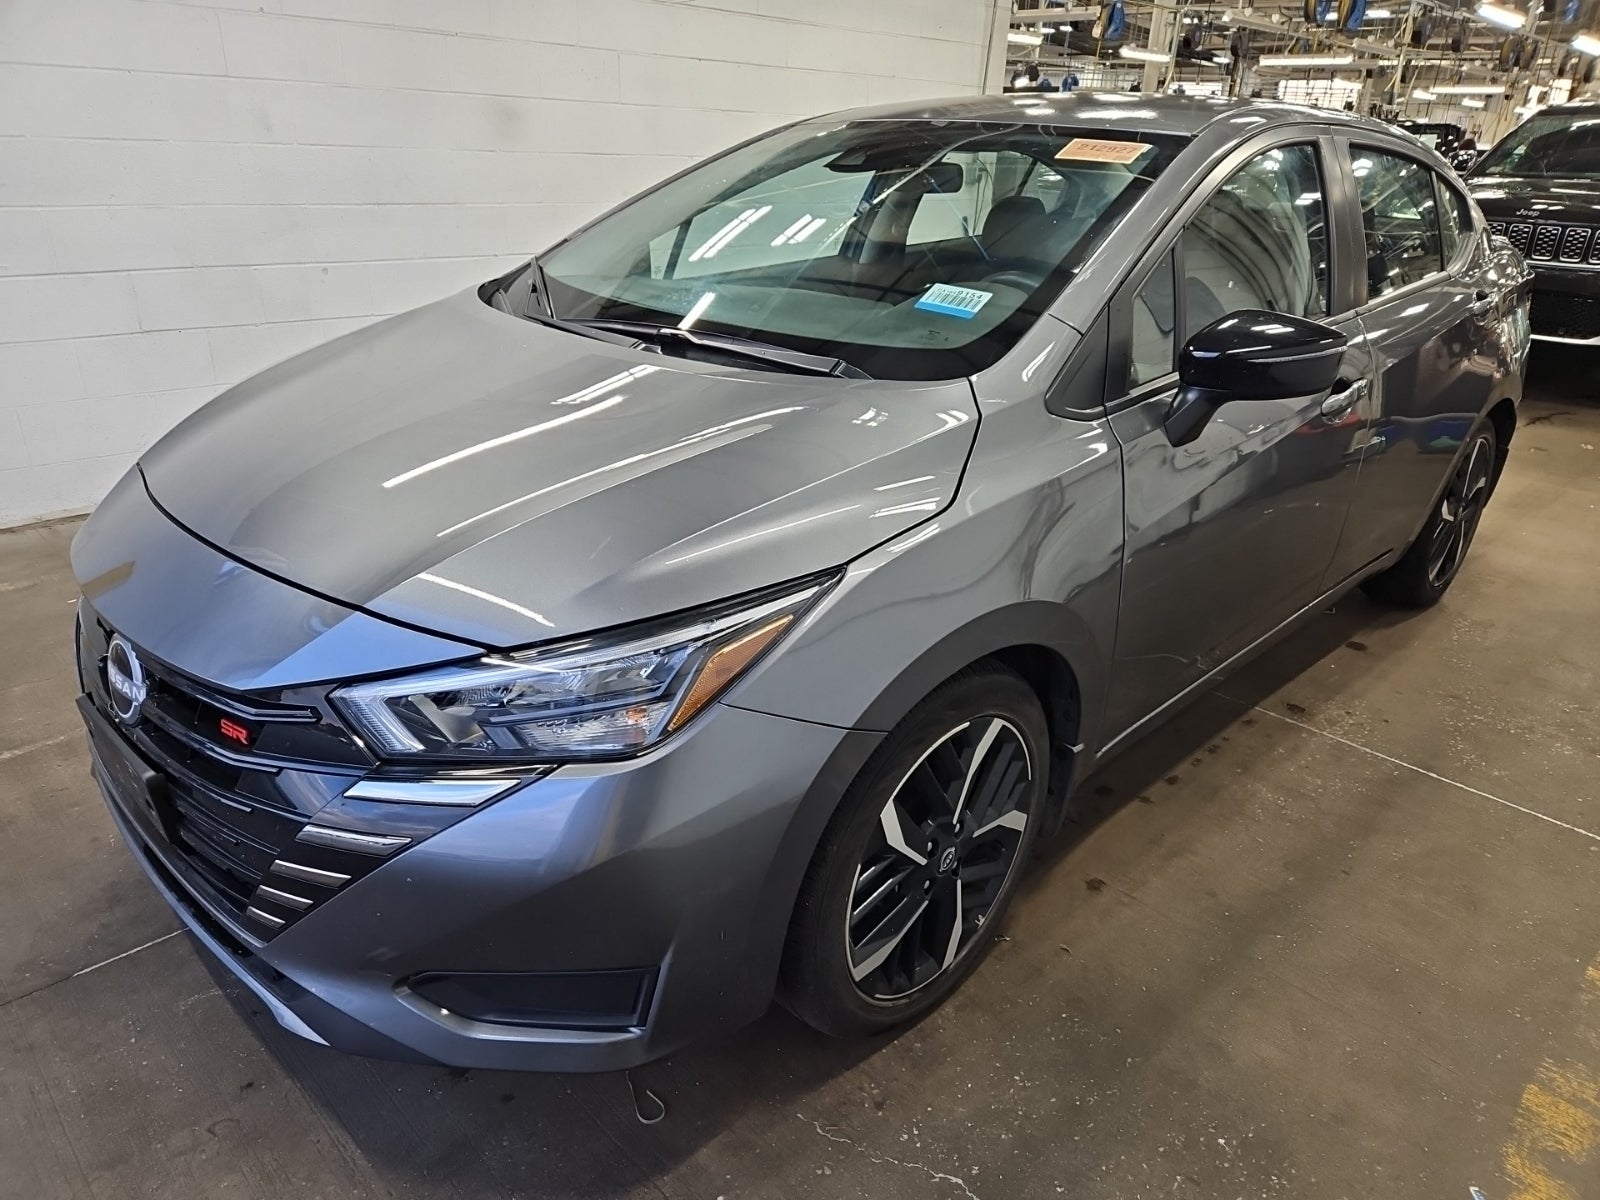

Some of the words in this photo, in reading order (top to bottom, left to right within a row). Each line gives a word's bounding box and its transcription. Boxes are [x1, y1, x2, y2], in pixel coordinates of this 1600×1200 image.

[1516, 208, 1540, 217] Jeep
[109, 667, 143, 702] SSAN
[220, 718, 248, 745] SR
